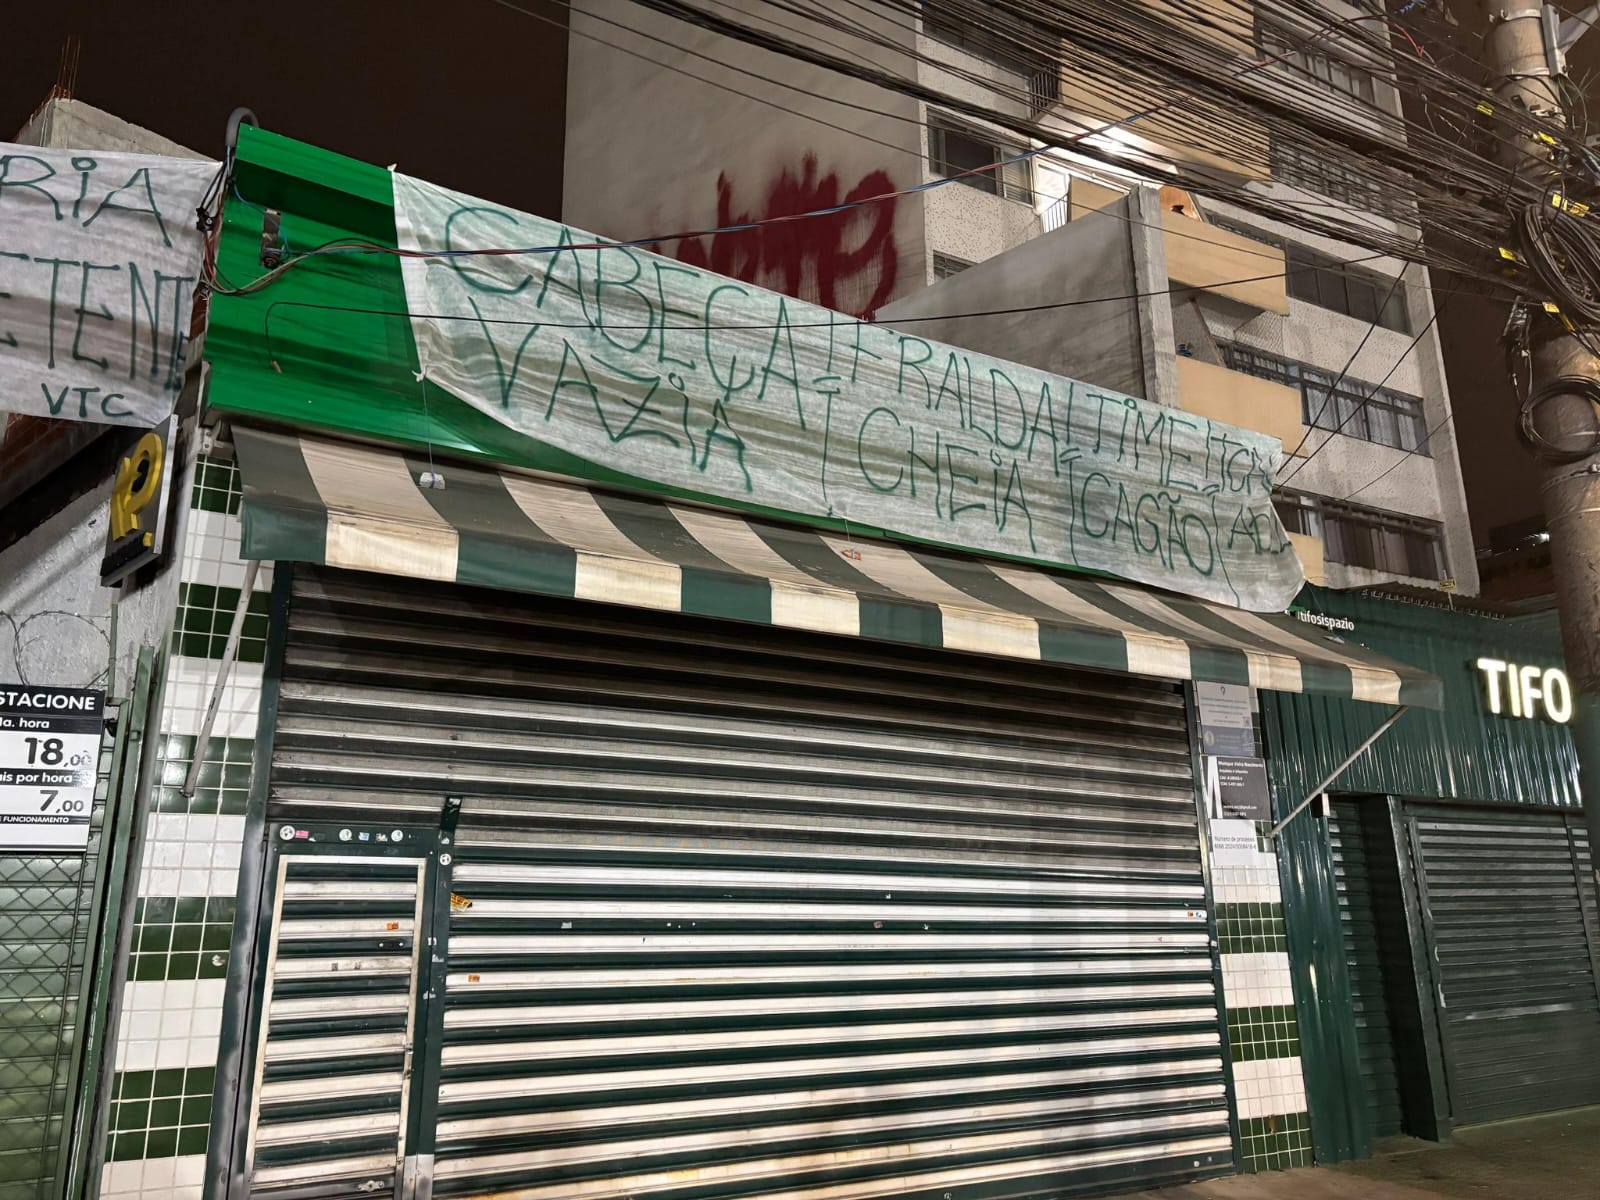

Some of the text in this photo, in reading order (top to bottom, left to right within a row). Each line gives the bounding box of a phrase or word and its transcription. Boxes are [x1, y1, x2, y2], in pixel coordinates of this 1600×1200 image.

[445, 206, 806, 431] CABEÇA
[41, 382, 134, 418] VTC
[1477, 657, 1573, 723] TIFO
[19, 717, 50, 729] hora
[16, 774, 40, 785] por
[42, 772, 73, 784] hora
[40, 790, 84, 813] 7,00
[3, 816, 70, 824] FUNCIONAMENTO
